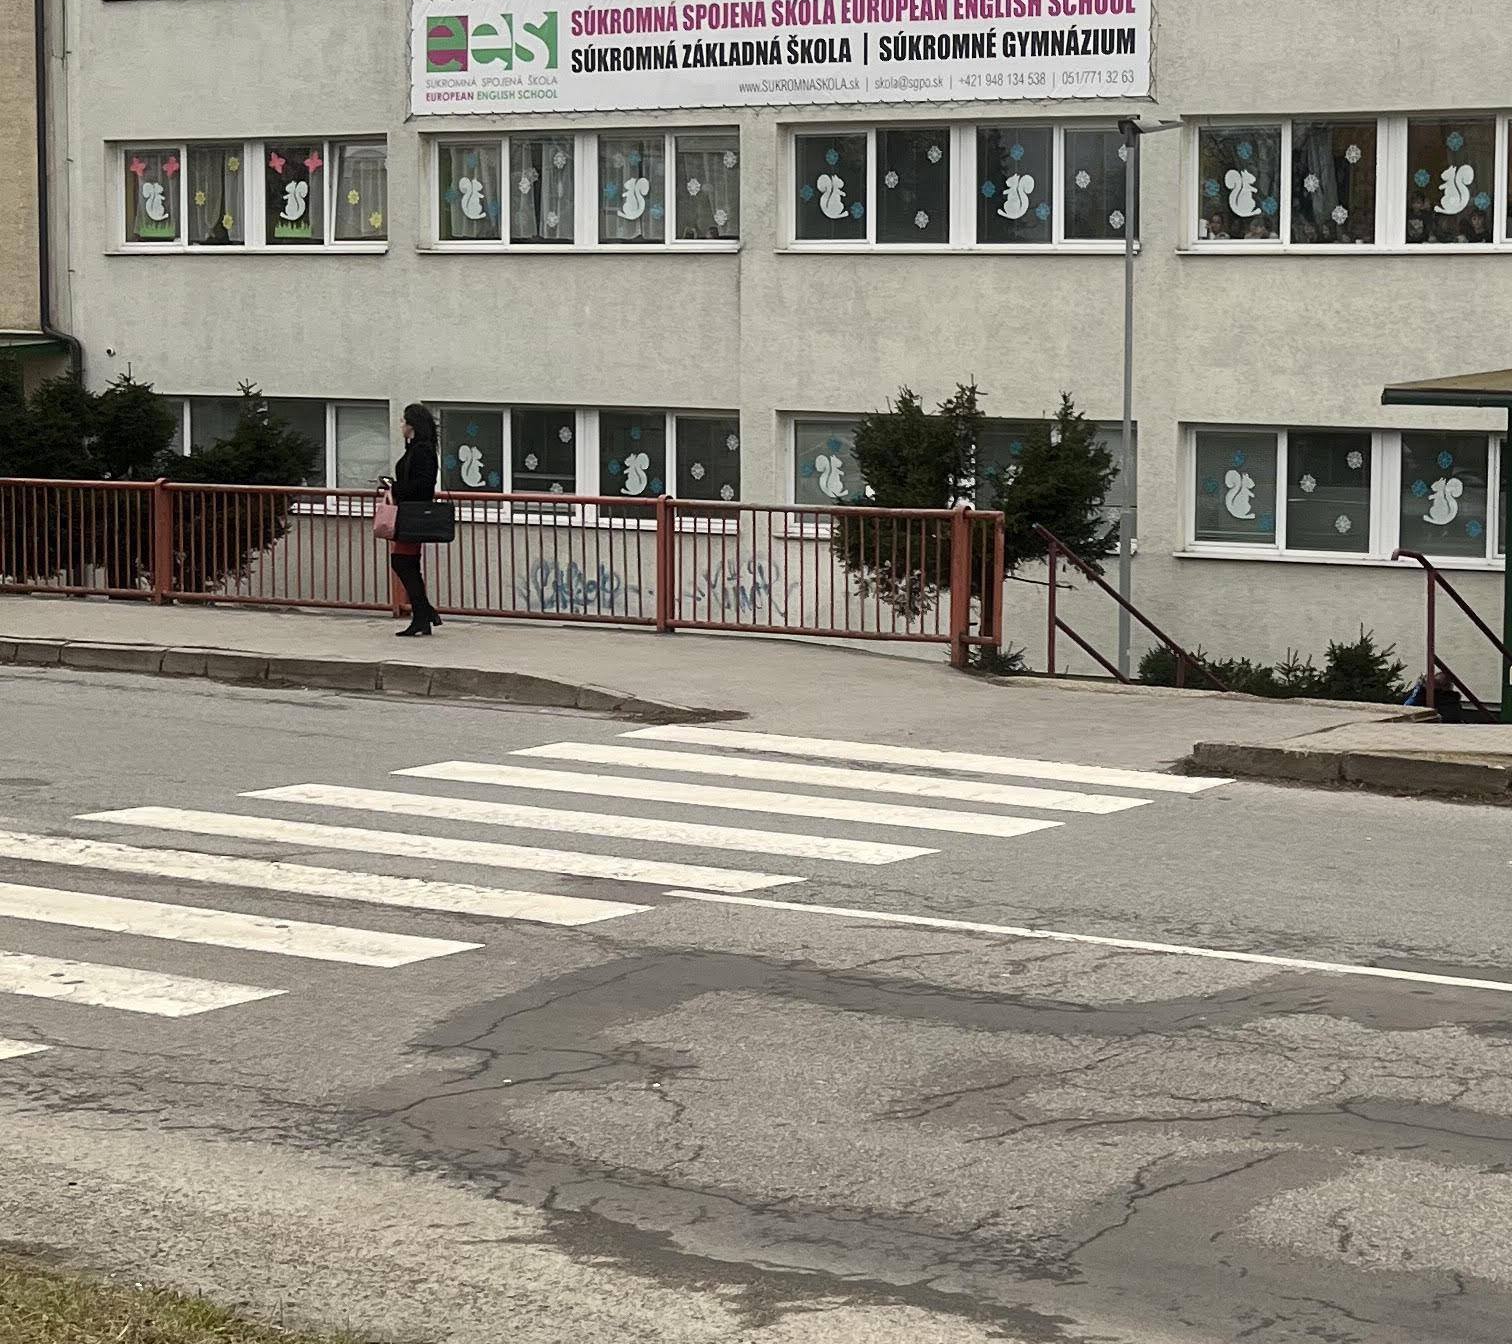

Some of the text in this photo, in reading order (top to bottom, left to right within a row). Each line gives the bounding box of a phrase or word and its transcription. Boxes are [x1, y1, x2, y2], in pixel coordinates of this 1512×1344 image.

[571, 1, 677, 37] SÚKROMNÁ
[571, 40, 678, 74] SÚKROMNÁ
[682, 35, 782, 68] ZÁKLADNÁ
[786, 34, 852, 65] ŠKOLA
[878, 27, 997, 62] SÚKROMNÉ
[1002, 24, 1136, 58] GYMNÁZIUM
[426, 89, 558, 102] EUROPEAN ENGLISH SCHOOL
[738, 77, 860, 93] www.SUKROMNASKOLA.sk
[960, 74, 982, 87] +421
[985, 72, 1003, 86] 948
[1007, 72, 1024, 86] 134
[1027, 71, 1046, 86] 538
[1062, 70, 1102, 85] 051/771
[1105, 70, 1119, 84] 32
[1121, 69, 1135, 83] 63
